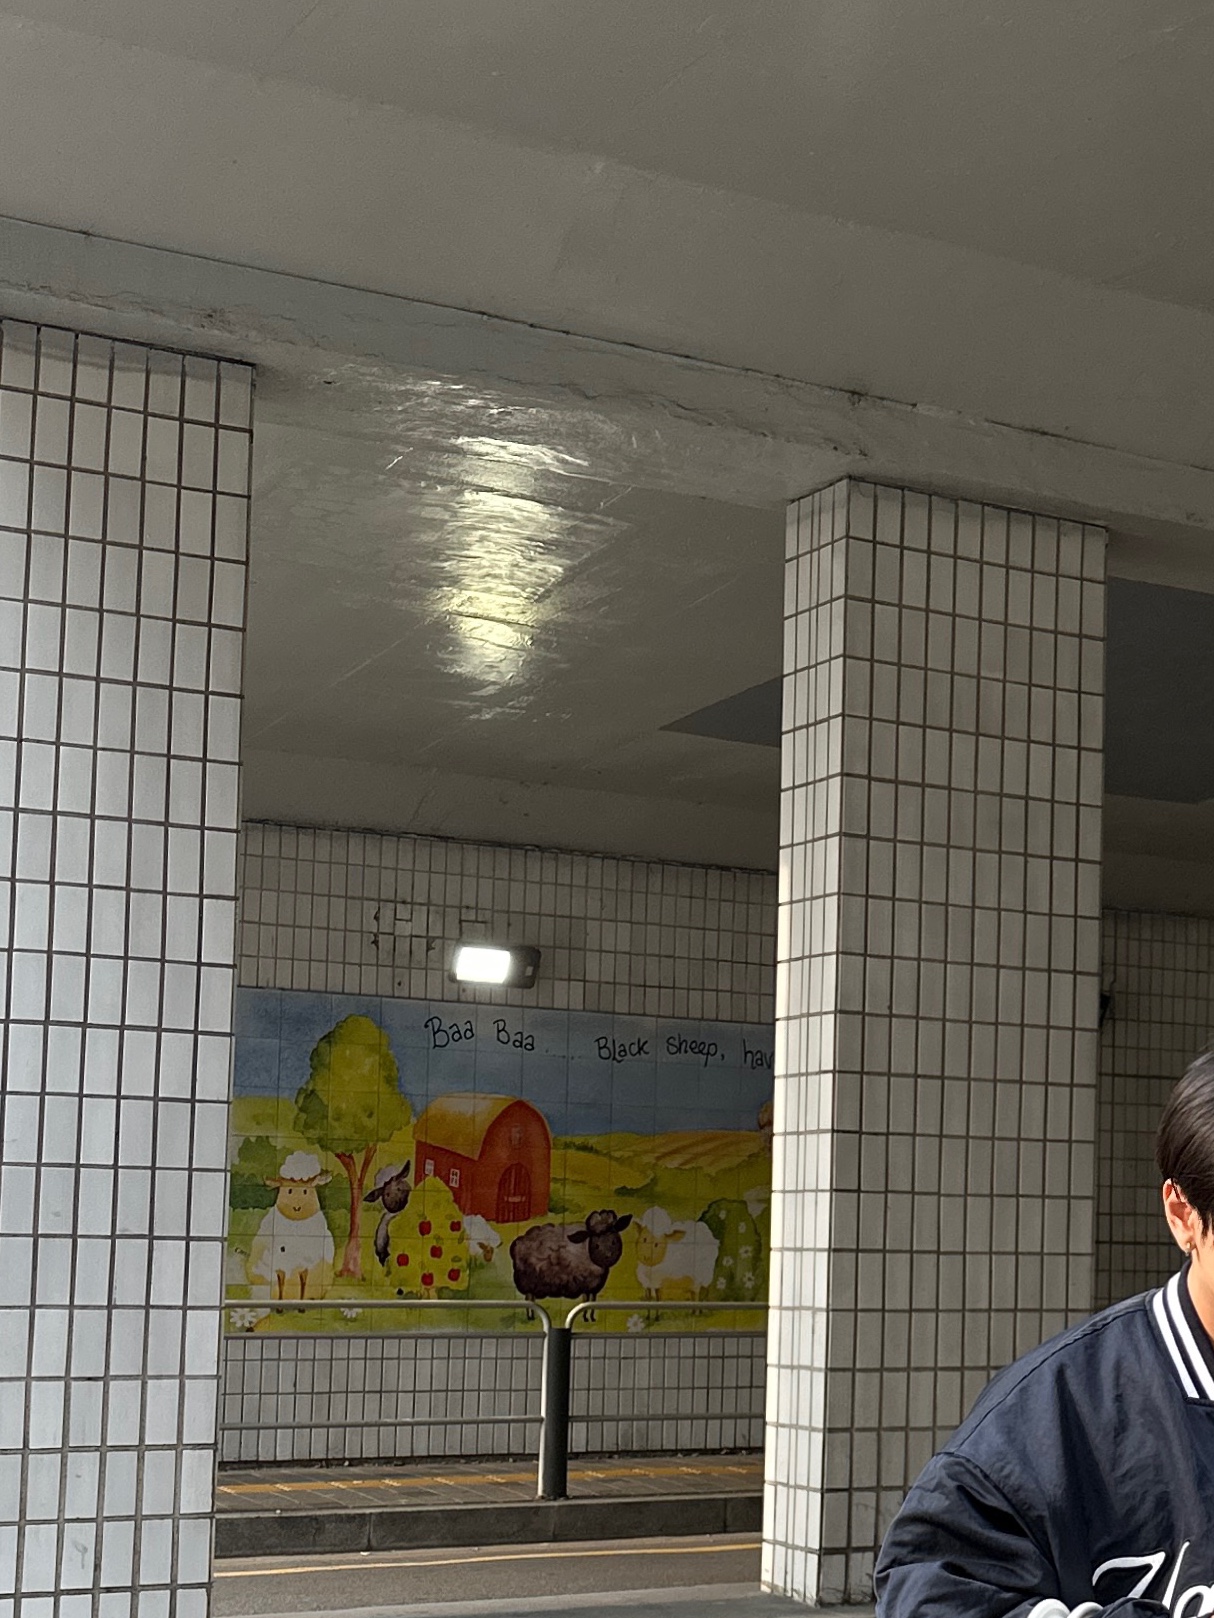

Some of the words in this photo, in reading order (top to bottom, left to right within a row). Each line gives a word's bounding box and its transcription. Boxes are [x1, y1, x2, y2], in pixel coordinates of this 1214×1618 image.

[424, 1016, 475, 1049] Baa
[493, 1019, 535, 1051] Baa
[594, 1036, 650, 1063] Black
